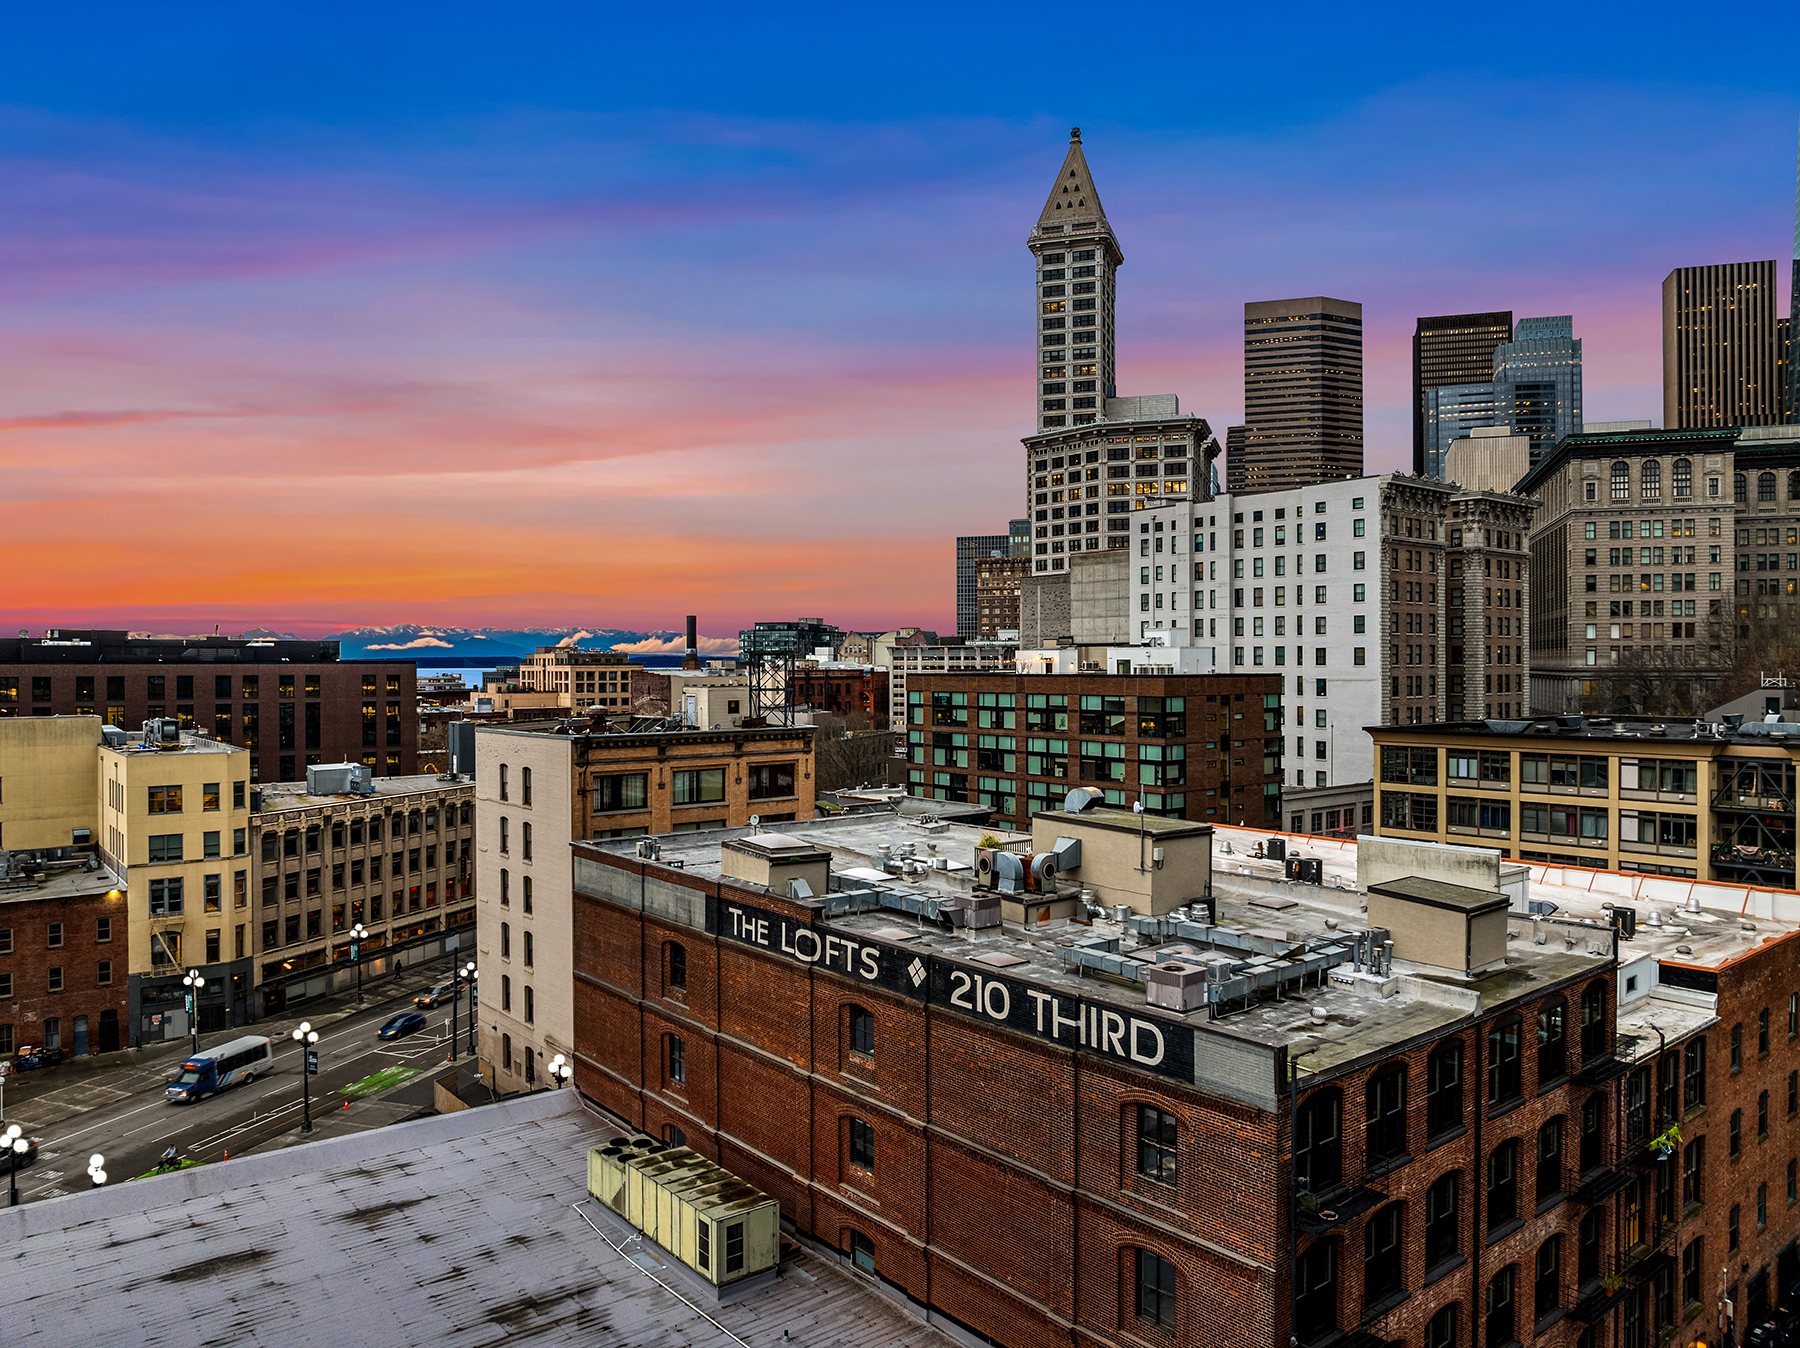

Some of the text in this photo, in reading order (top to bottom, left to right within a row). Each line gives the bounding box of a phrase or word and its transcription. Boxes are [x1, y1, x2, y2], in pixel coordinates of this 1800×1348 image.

[728, 906, 1165, 1066] THE LOFTS 210 THIRD
